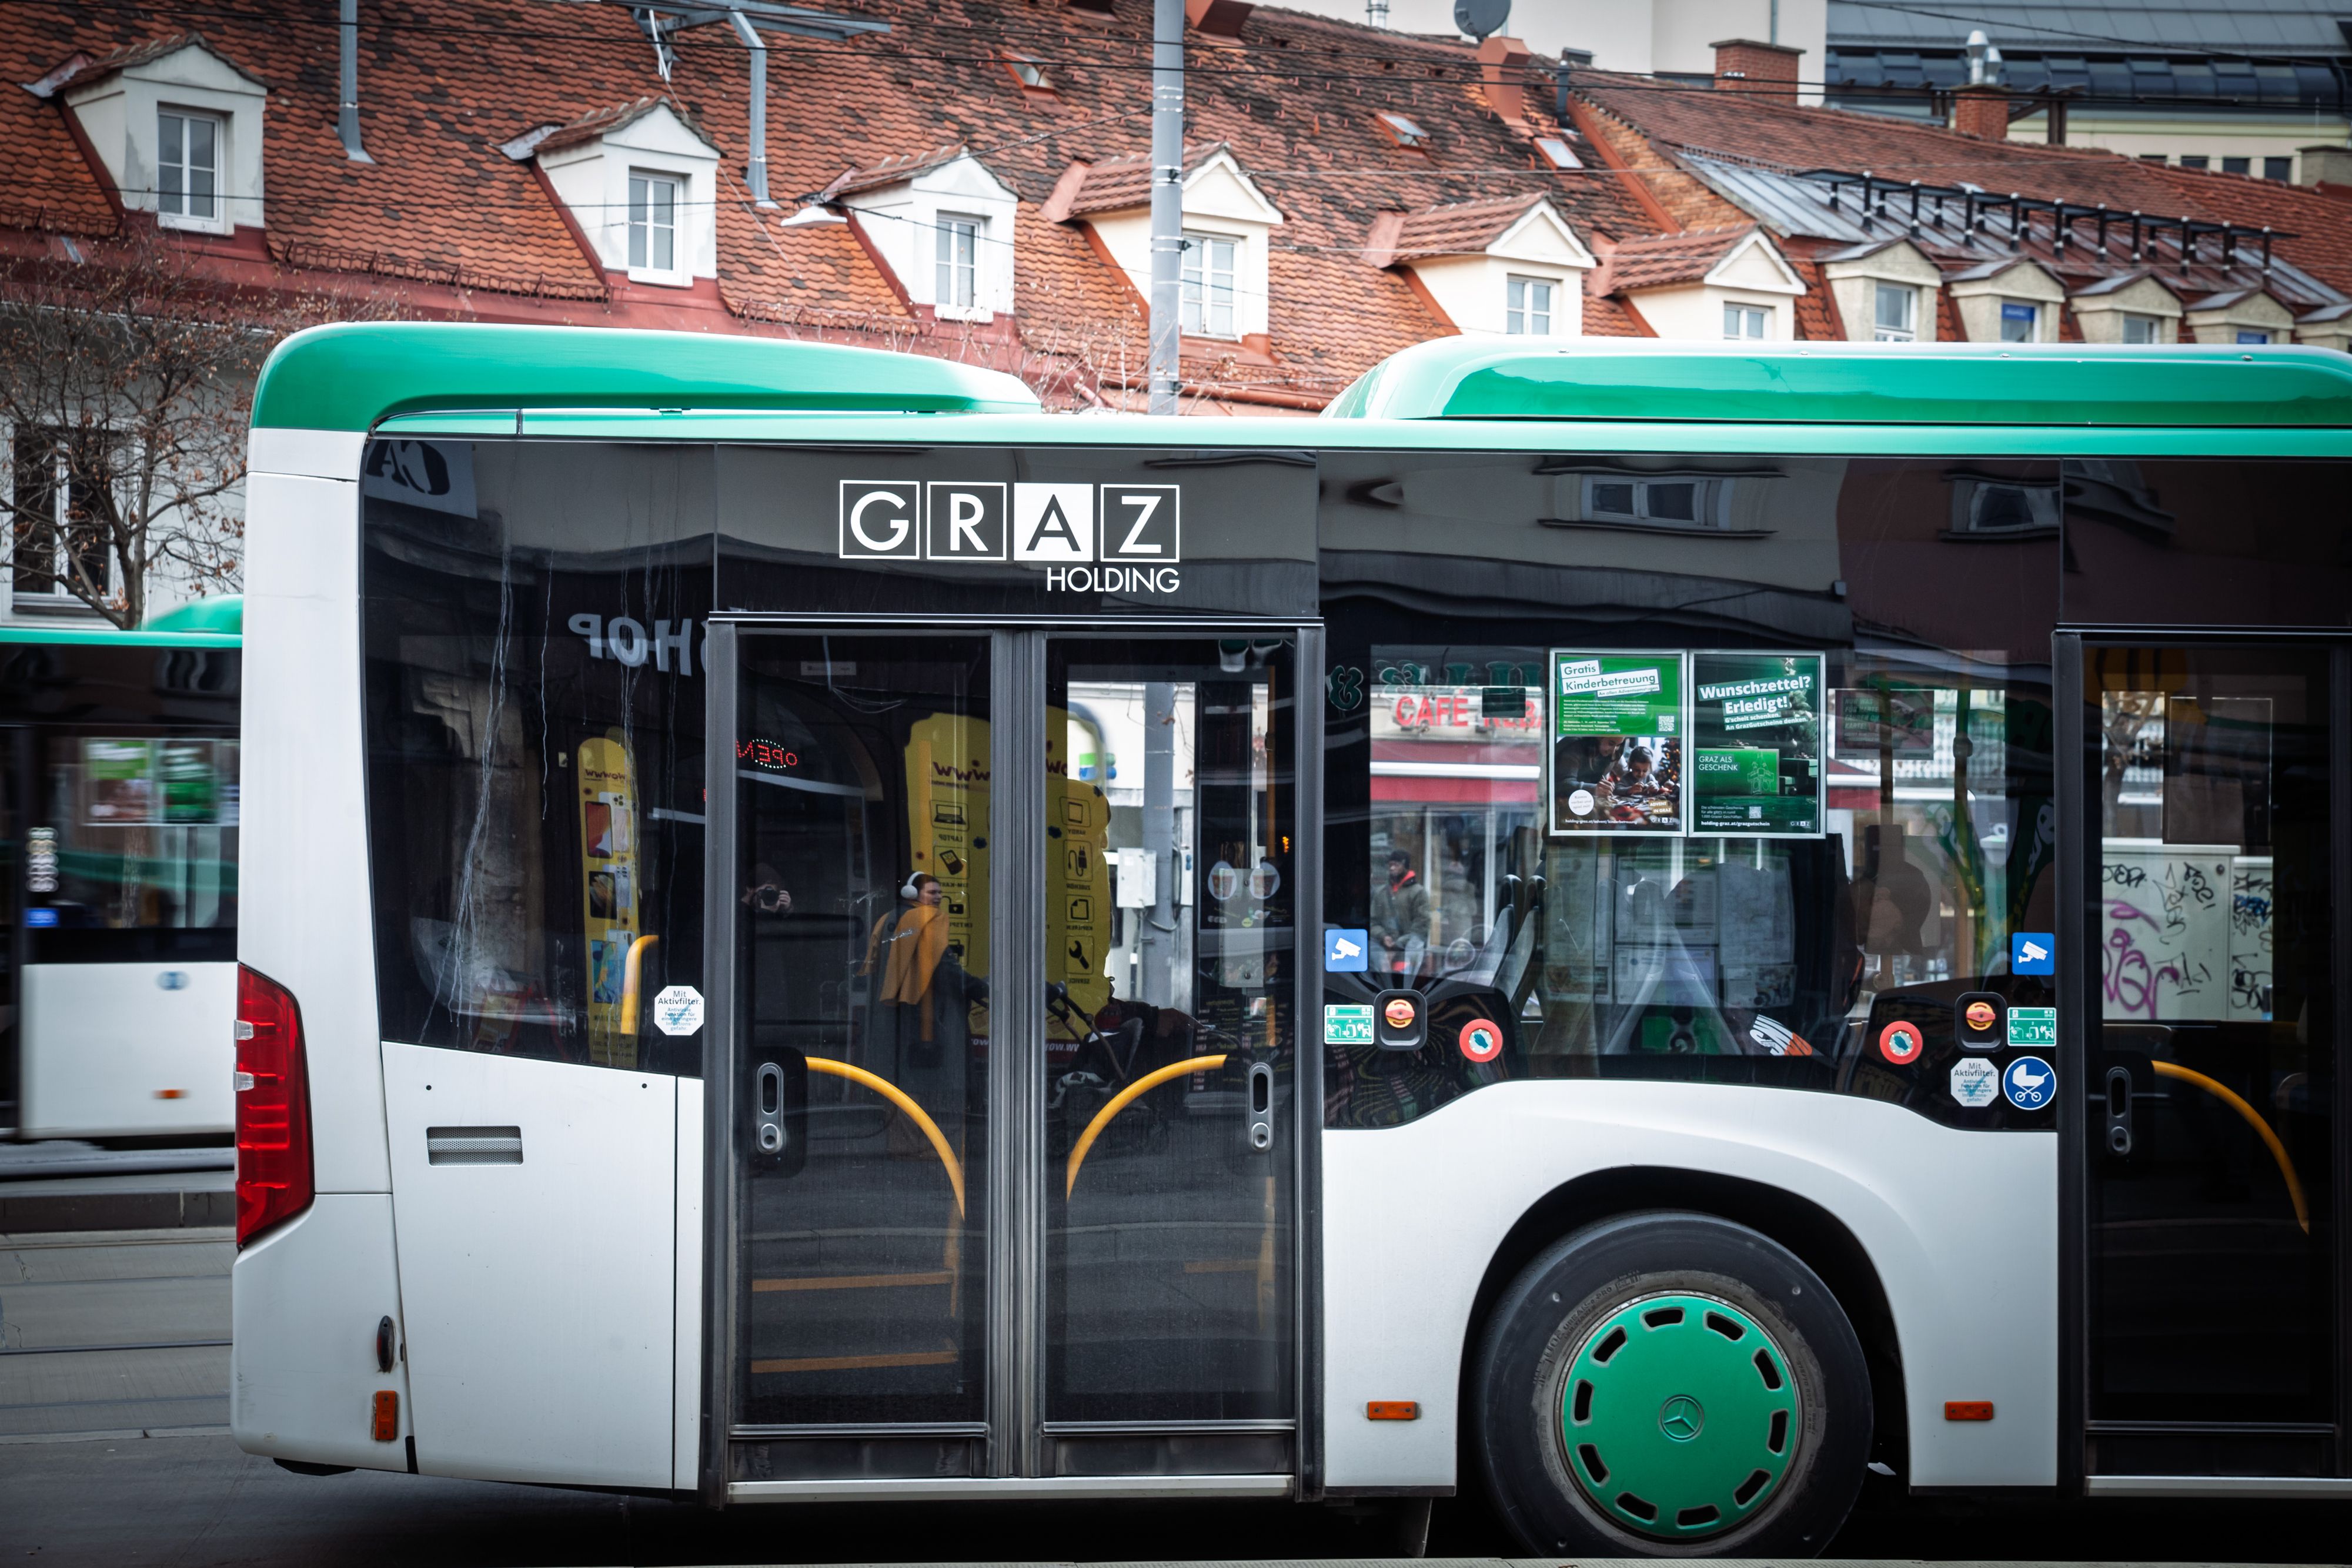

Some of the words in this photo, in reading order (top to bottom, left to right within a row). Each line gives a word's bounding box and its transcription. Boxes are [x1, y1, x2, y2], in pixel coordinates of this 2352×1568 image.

[850, 491, 1162, 554] GRAZ
[1047, 566, 1180, 593] HOLDING
[1564, 664, 1596, 675] Gratis
[1566, 675, 1656, 691] Kinderbetreuung
[1700, 676, 1811, 699] Wunschzettel?
[1396, 688, 1468, 727] CAFÉ
[1725, 696, 1788, 714] Erledigt!
[1725, 715, 1749, 723] G'scheit
[1750, 713, 1781, 721] schenken.
[1735, 720, 1783, 730] GrazGutscheine
[1783, 716, 1809, 724] denken.
